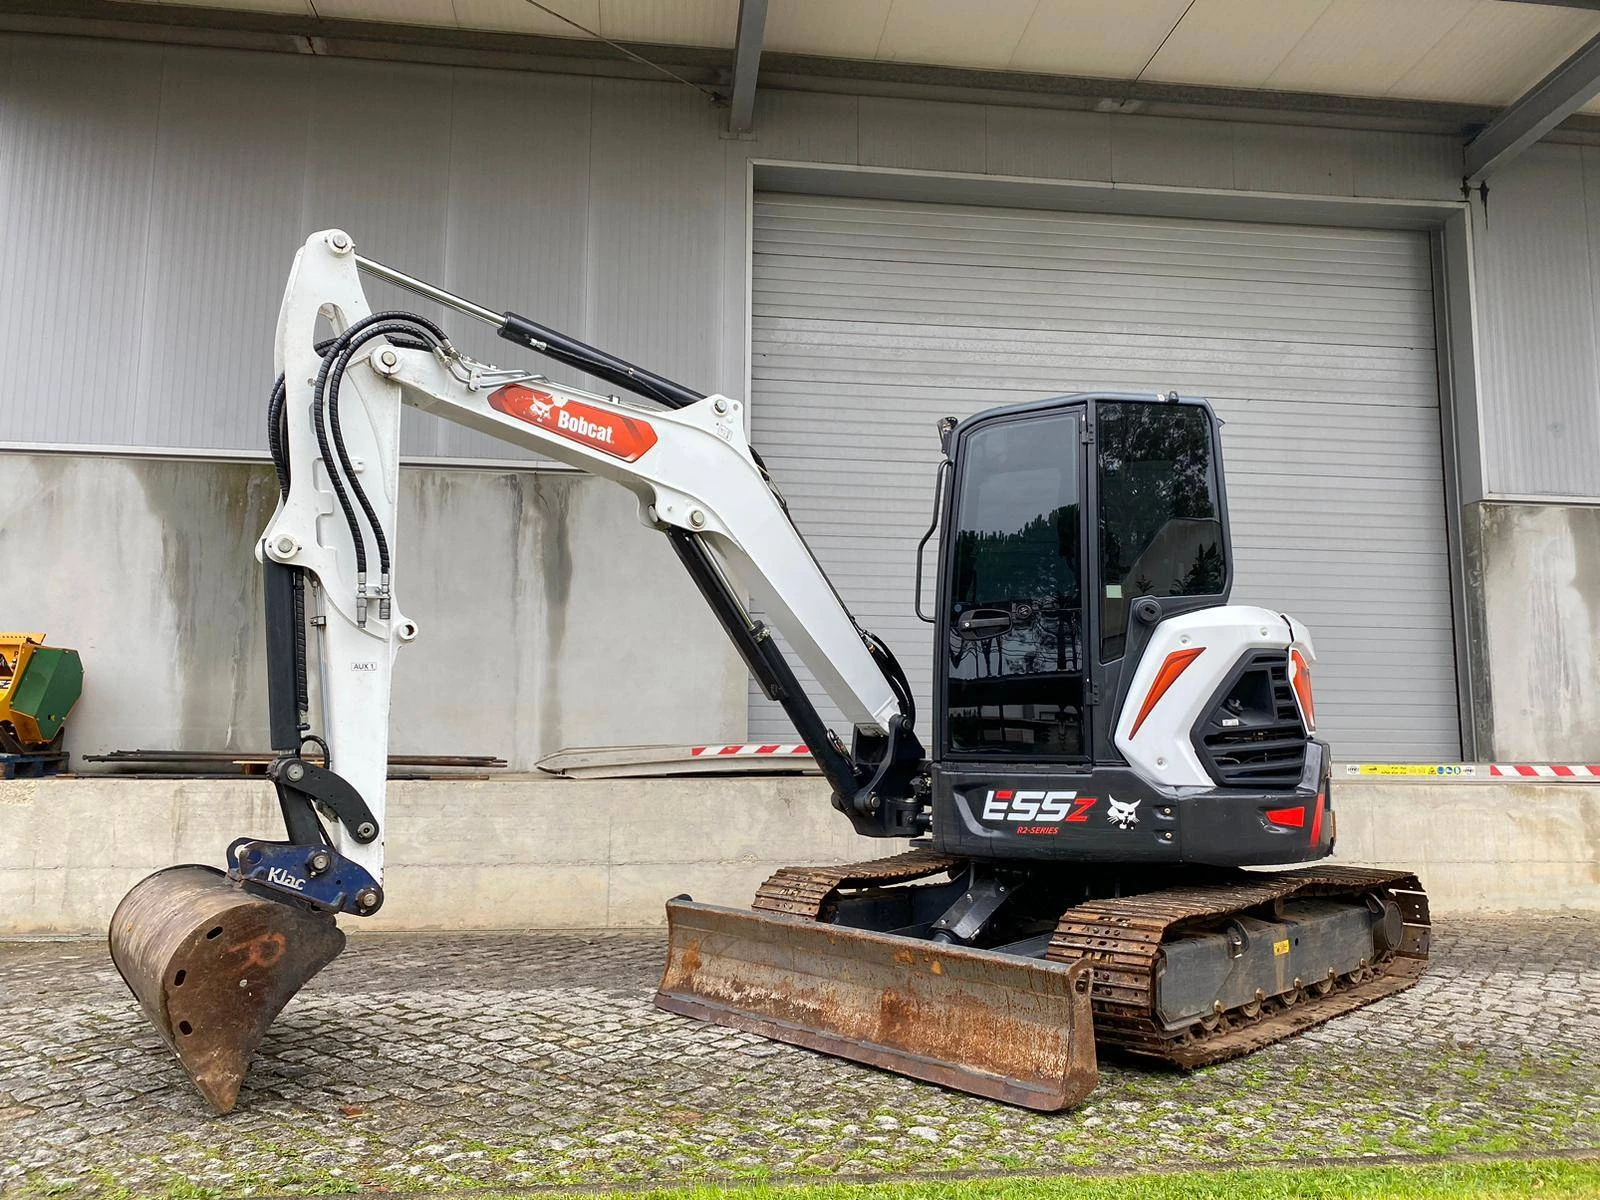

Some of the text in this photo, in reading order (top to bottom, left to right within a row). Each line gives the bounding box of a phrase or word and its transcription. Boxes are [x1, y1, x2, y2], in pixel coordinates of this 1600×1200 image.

[557, 409, 613, 444] Bobcat
[1016, 826, 1059, 835] R2-SERIES
[267, 866, 306, 890] Klac
